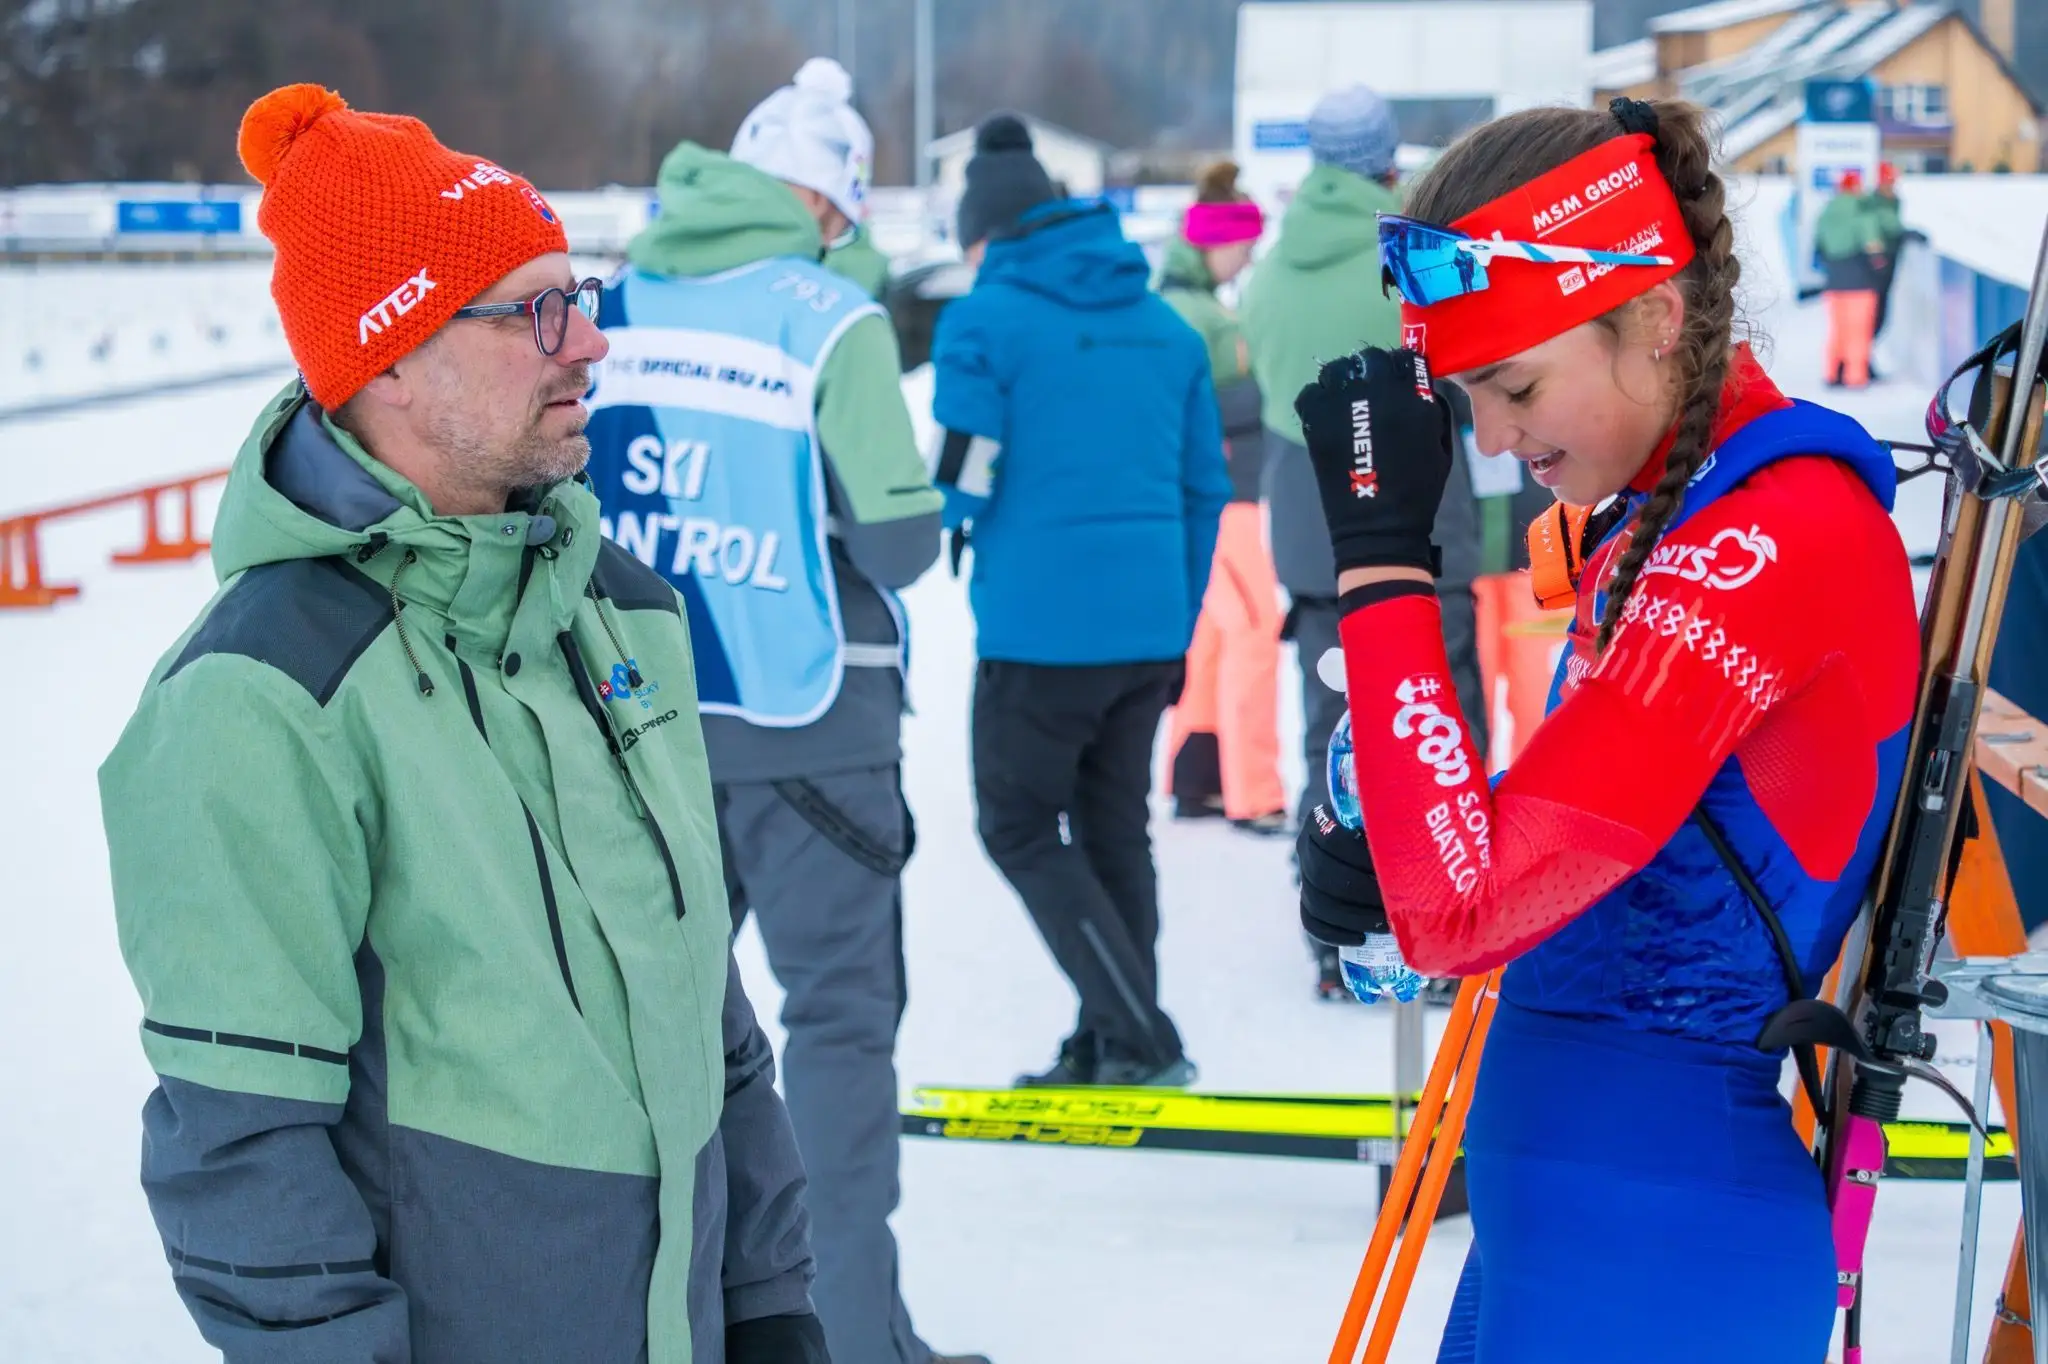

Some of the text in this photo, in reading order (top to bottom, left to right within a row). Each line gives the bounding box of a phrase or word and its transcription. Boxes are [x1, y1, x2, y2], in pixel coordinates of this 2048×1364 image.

[1531, 161, 1640, 231] MSM GROUP
[357, 267, 438, 345] ATEX
[621, 433, 711, 501] SKI
